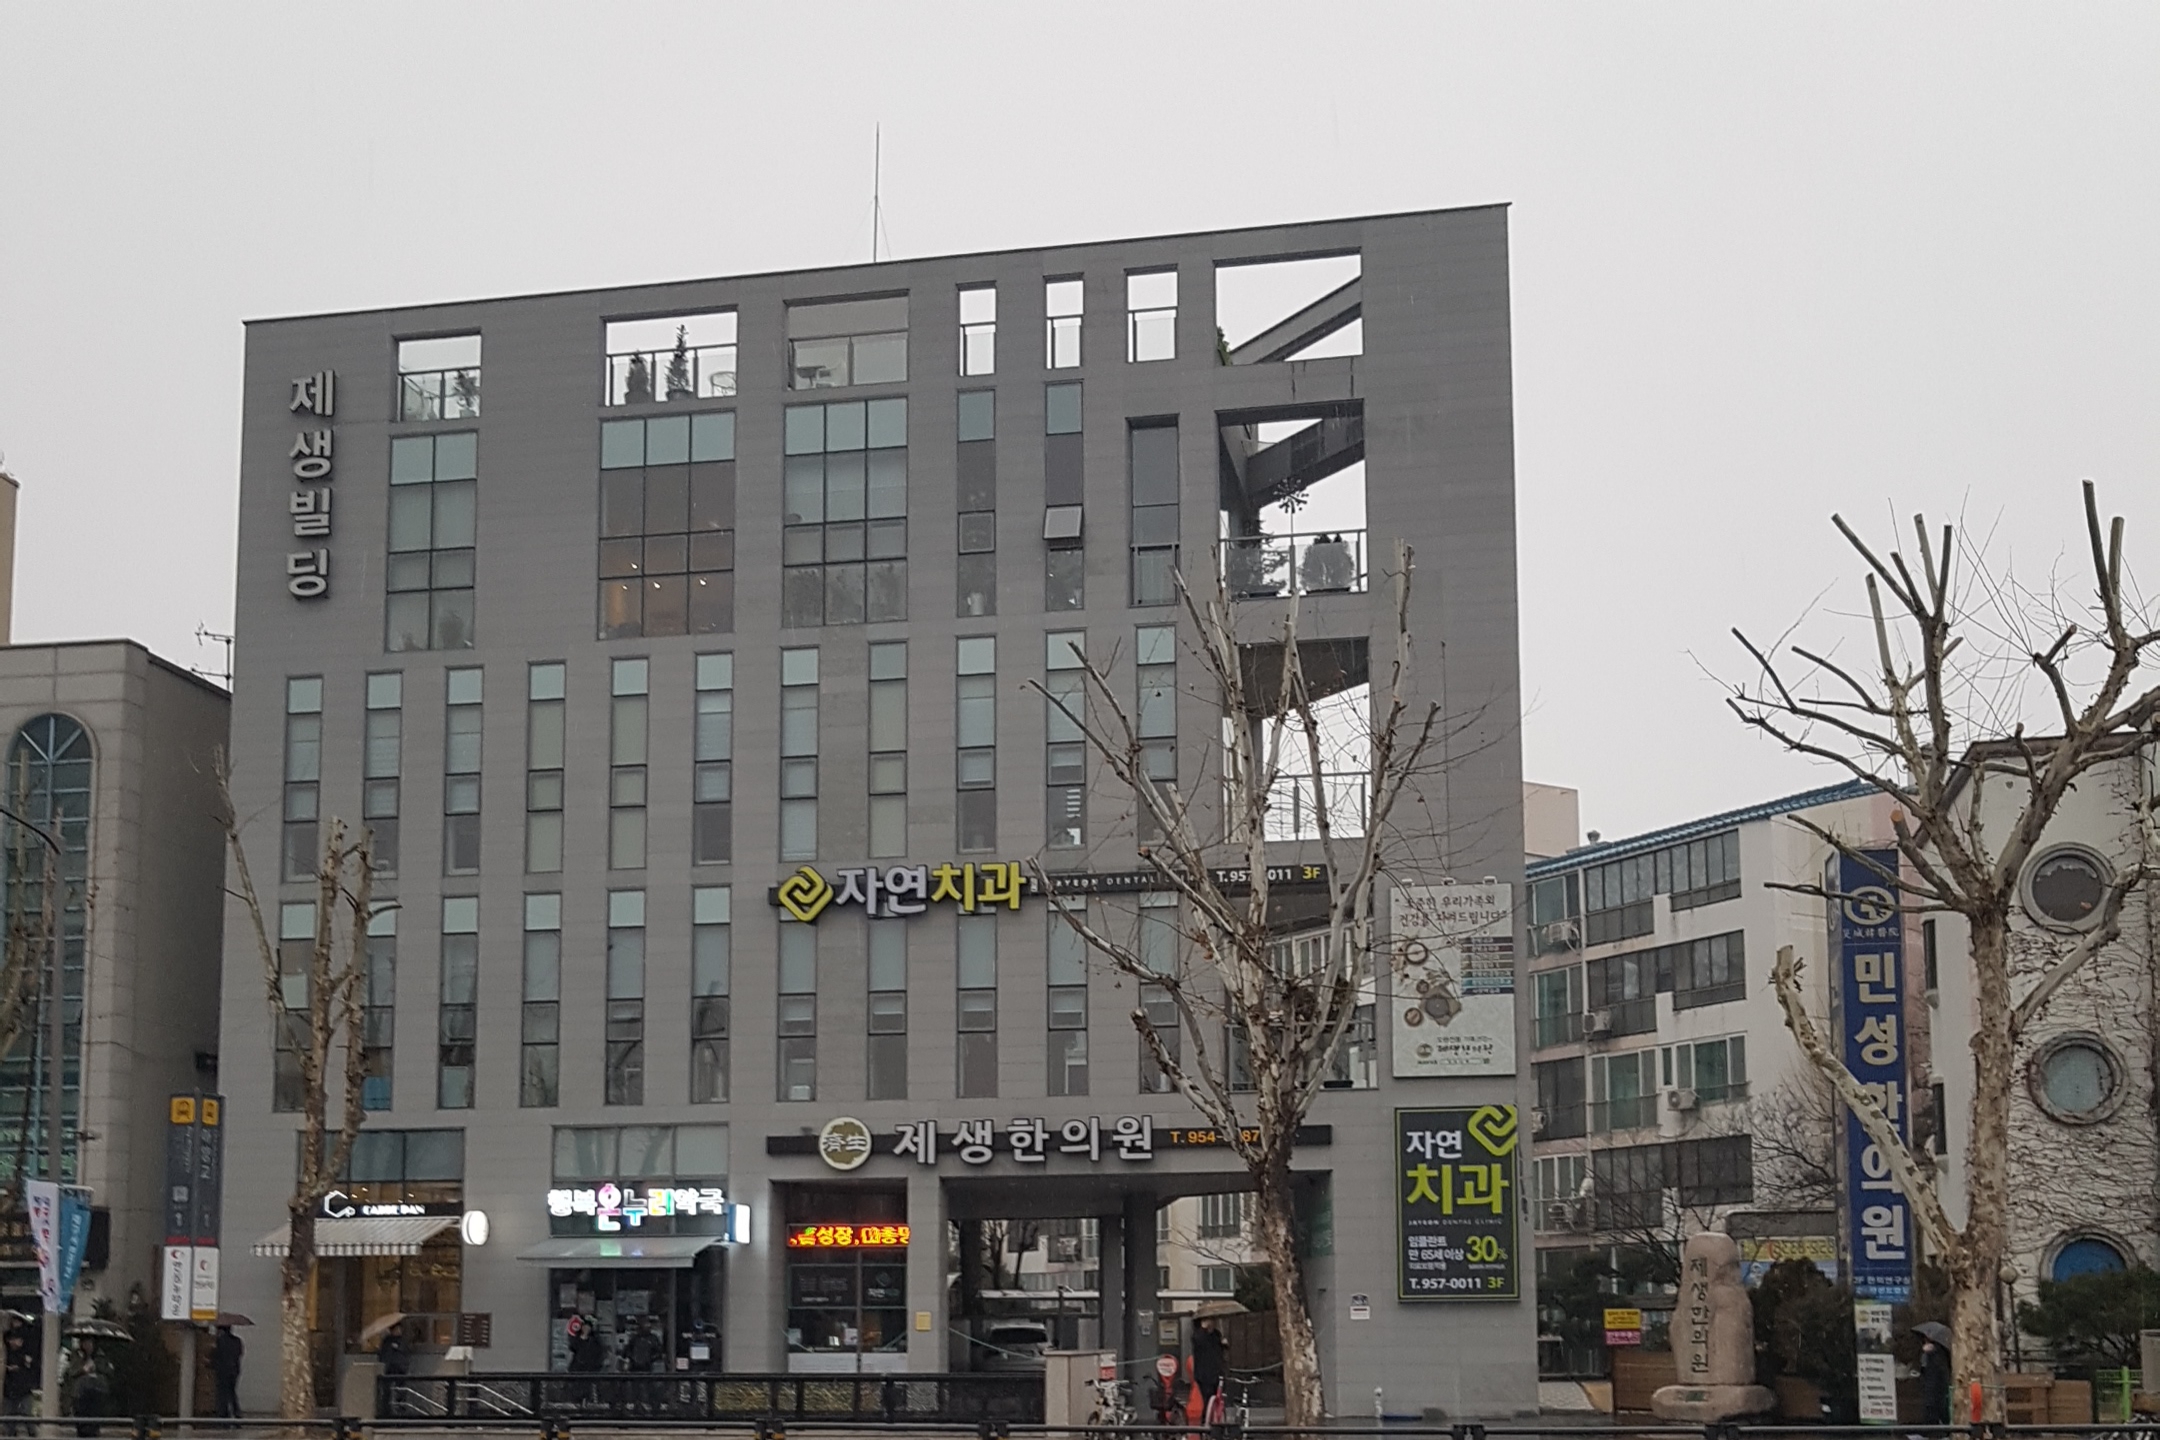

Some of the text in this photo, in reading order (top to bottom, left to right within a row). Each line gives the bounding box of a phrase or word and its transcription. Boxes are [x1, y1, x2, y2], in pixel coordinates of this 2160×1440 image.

[286, 369, 336, 600] 제생빌딩
[836, 862, 1027, 915] 자연치과
[1302, 865, 1321, 880] 3F
[893, 1114, 1153, 1165] 제생한의원
[1406, 1129, 1463, 1160] 자연
[1406, 1163, 1510, 1215] 치과
[1409, 1276, 1505, 1290] T.957-0011 3F
[1689, 1257, 1710, 1374] 제생한의원
